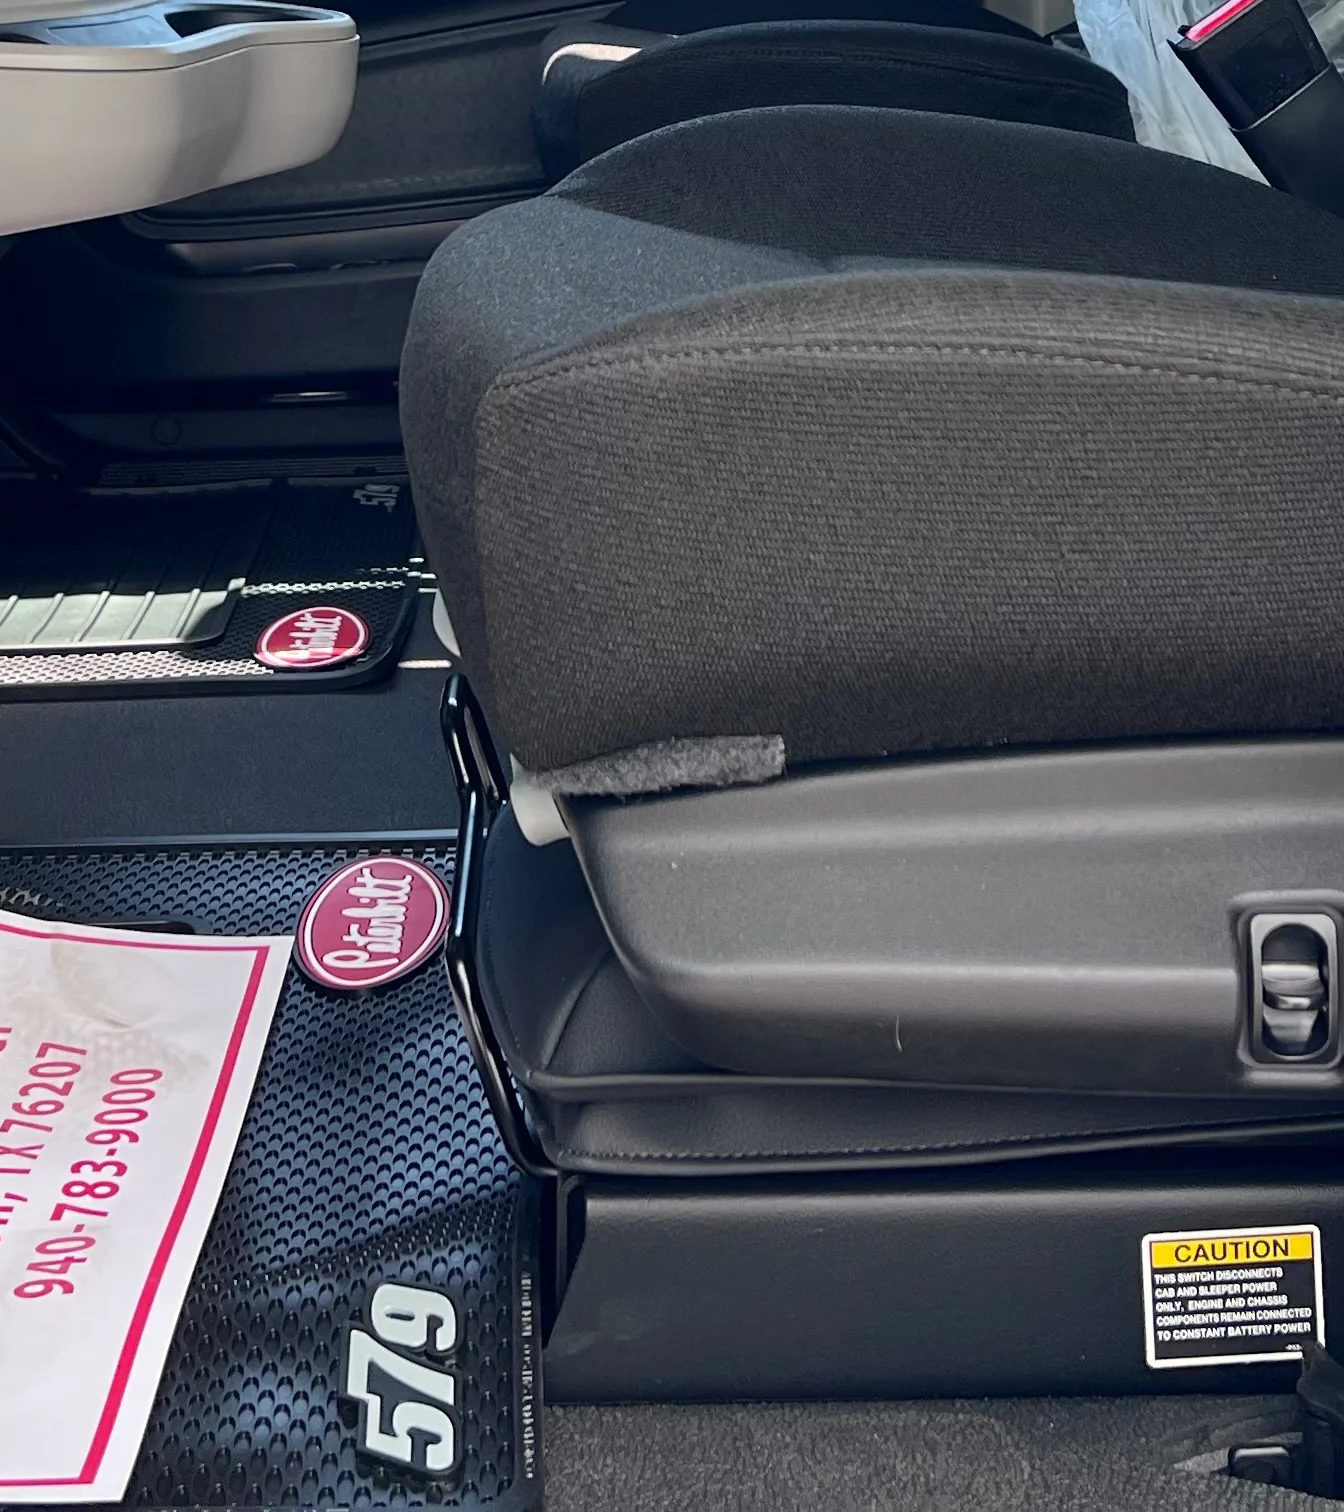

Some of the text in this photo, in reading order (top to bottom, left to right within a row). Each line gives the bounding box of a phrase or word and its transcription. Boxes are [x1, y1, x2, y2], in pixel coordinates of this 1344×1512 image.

[321, 866, 415, 971] Peterbilt
[12, 1067, 164, 1302] 940-783-9000
[1174, 1238, 1290, 1263] CAUTION
[1154, 1266, 1284, 1285] THIS SWITCH DISCONNECTS
[1155, 1281, 1278, 1299] CAB AND SLEEPER POWER
[1187, 1298, 1224, 1311] ENGINE
[1225, 1296, 1246, 1309] AND
[1246, 1294, 1288, 1307] CHASSIS
[1156, 1307, 1313, 1327] COMPONENTS REMAIN CONNECTED
[1157, 1321, 1312, 1342] TO CONSTANT BATTERY POWER
[346, 1282, 457, 1472] 579
